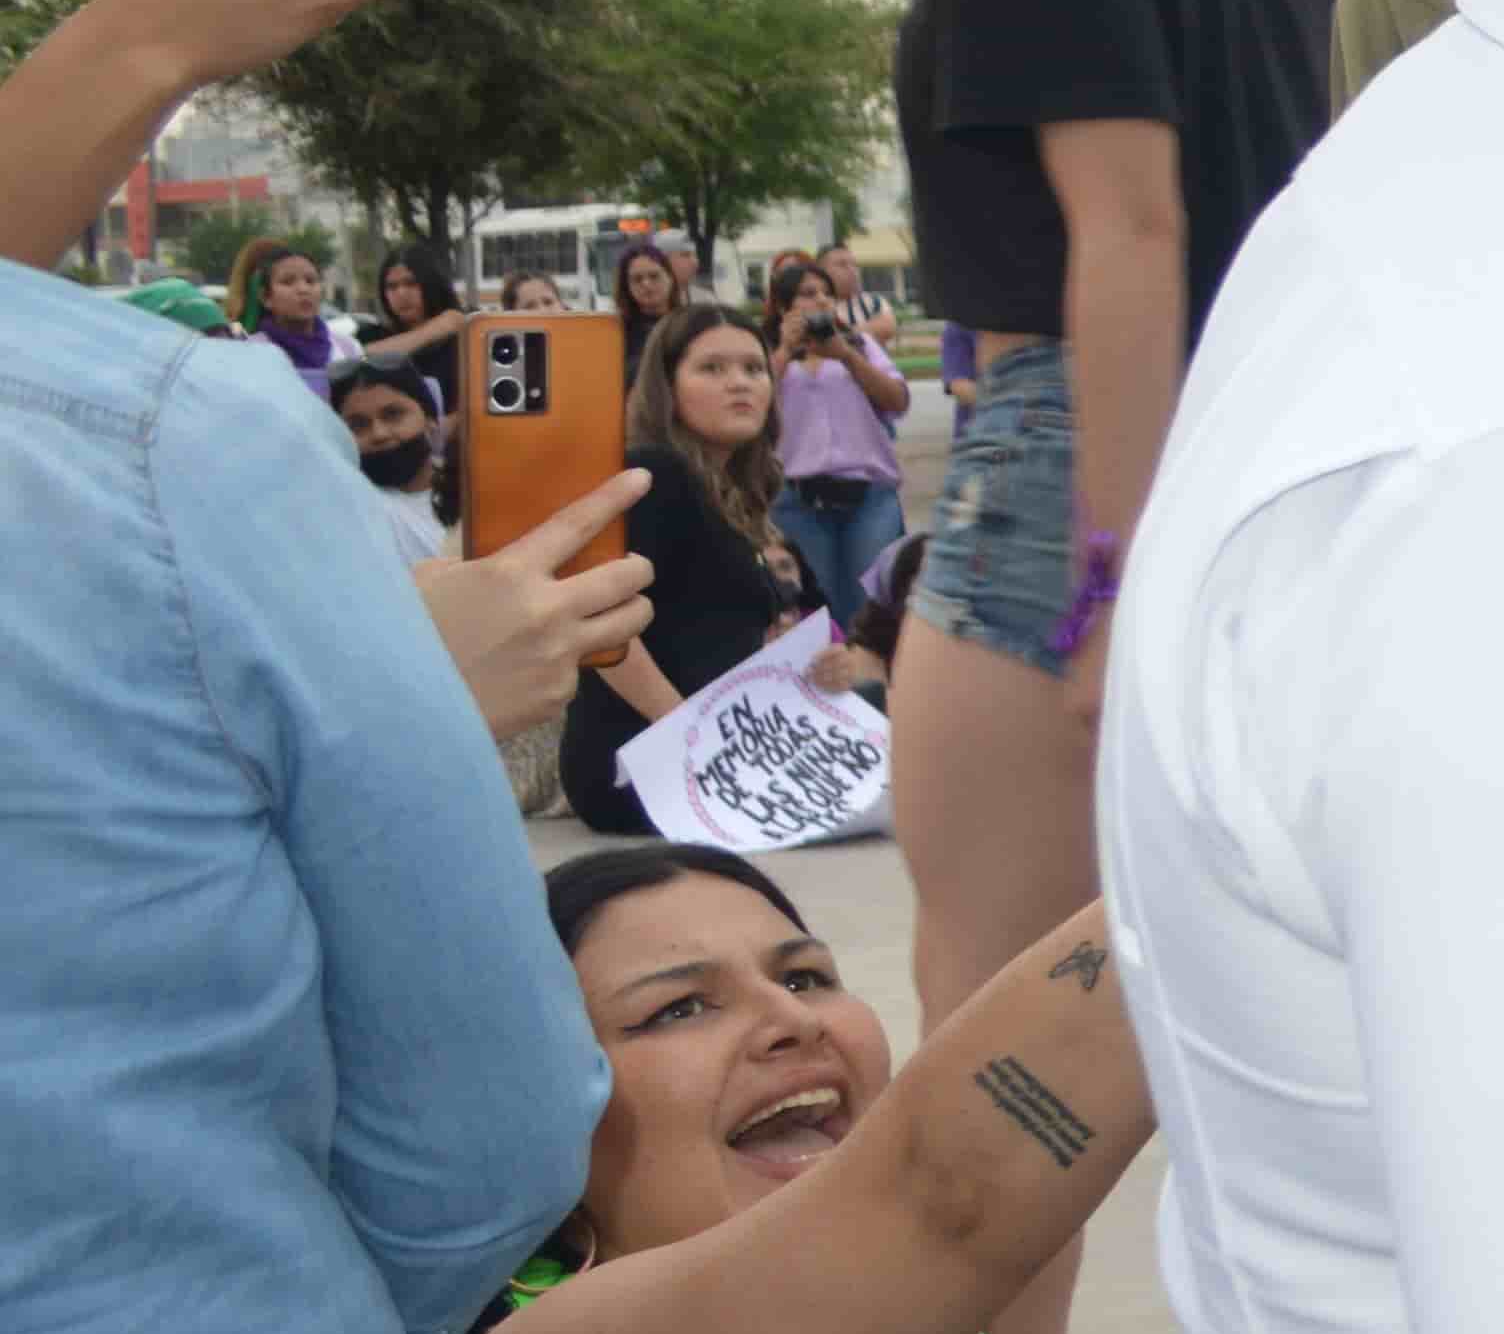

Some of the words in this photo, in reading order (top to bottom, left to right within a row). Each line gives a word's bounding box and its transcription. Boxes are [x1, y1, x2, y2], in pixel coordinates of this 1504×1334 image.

[716, 692, 755, 740] EN
[695, 703, 791, 796] MEMORIA
[750, 714, 819, 775] TODAS
[840, 739, 882, 780] NO
